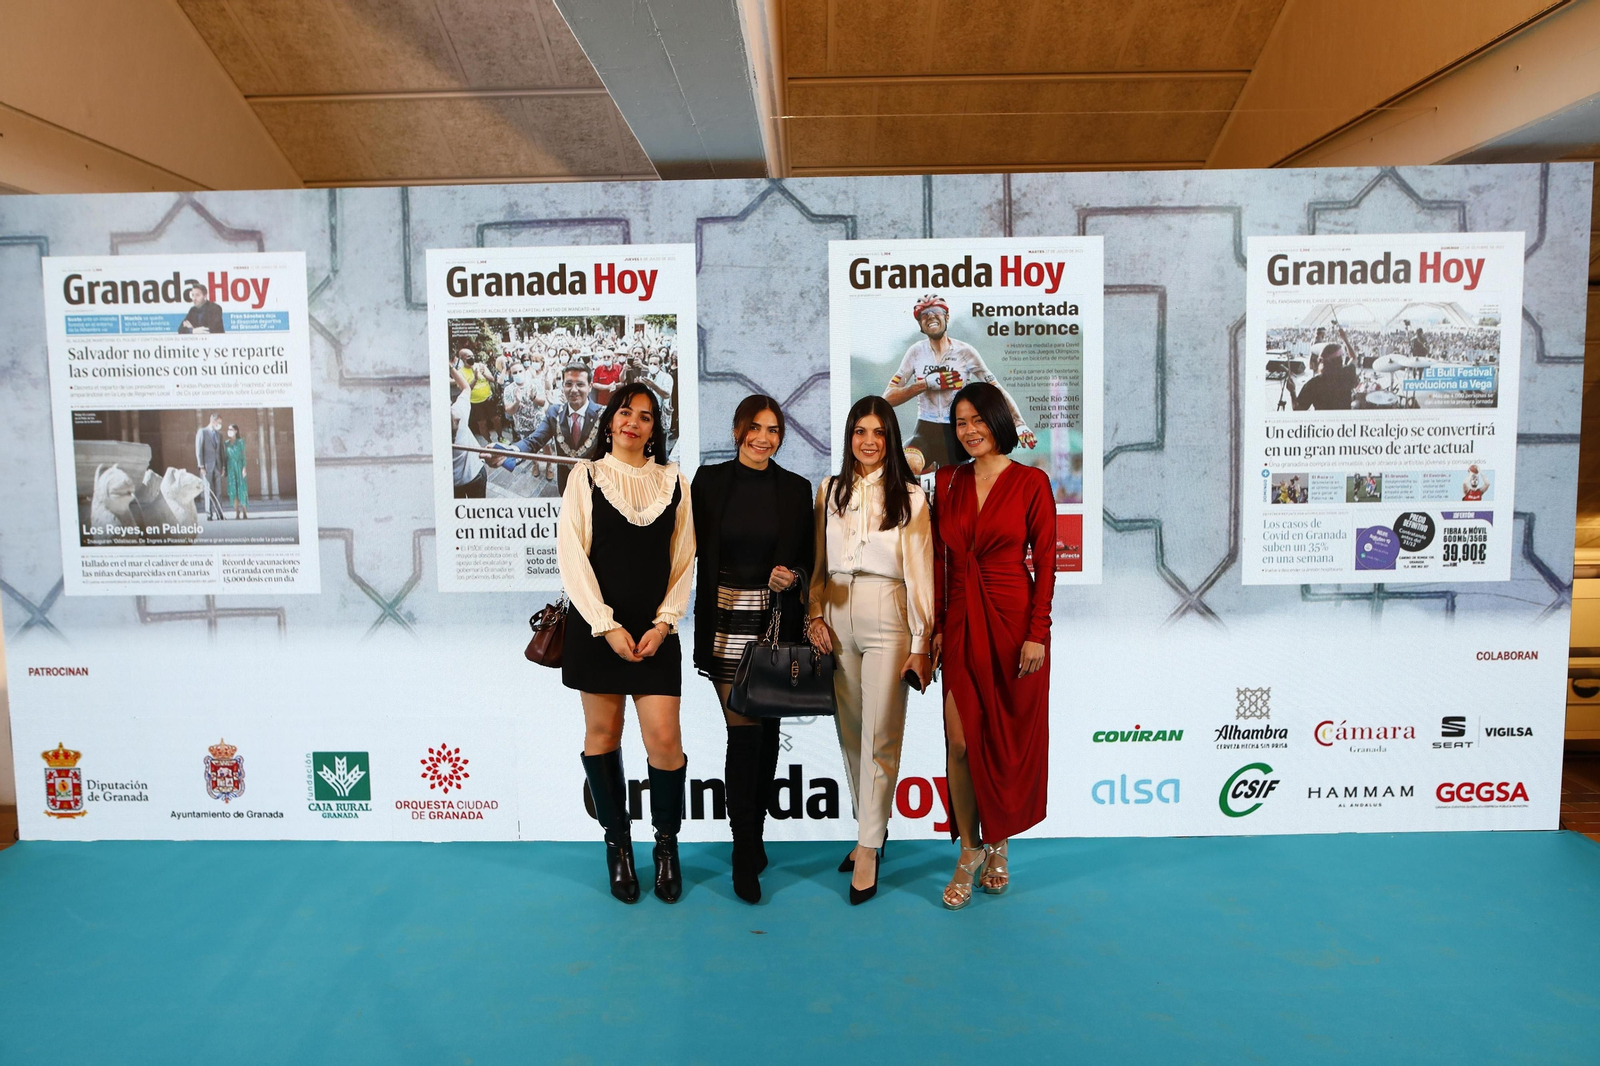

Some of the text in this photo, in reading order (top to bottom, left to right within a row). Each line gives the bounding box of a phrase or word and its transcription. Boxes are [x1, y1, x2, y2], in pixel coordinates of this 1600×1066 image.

[849, 255, 1066, 295] Granada Hoy
[1267, 251, 1486, 291] Granada Hoy
[446, 263, 658, 301] Granada Hoy
[63, 271, 270, 309] Granada Hoy
[971, 301, 1079, 318] Remontada
[987, 320, 1079, 337] de bronce
[68, 345, 285, 361] Salvador no dimite y se reparte
[68, 361, 289, 378] las comisiones con su único edil
[1426, 367, 1492, 377] El Bull Festival
[1405, 380, 1492, 390] revoluciona la Vega
[1039, 412, 1058, 421] poder
[1034, 421, 1049, 429] algo
[1265, 422, 1495, 440] Un edificio del Realejo se convertirá
[1264, 440, 1474, 459] en un gran museo de arte actual
[455, 502, 561, 519] Cuenca vuelv
[1263, 518, 1322, 529] Los casos de
[1409, 513, 1427, 524] PRECIO
[82, 523, 204, 537] Los Reyes, en Palacio
[455, 522, 550, 539] en mitad de
[1402, 519, 1428, 533] DEFINITIVO
[1443, 527, 1462, 535] FIBRA
[1468, 526, 1487, 534] MÓVIL
[1262, 530, 1290, 541] Covid
[1305, 529, 1347, 540] Granada
[1399, 527, 1427, 540] Contratando
[1443, 534, 1488, 543] 600Mb/35GB
[526, 547, 557, 555] El casti
[1262, 542, 1329, 553] suben un 35%
[1443, 543, 1487, 563] 39,90€
[81, 560, 109, 568] Hallado
[144, 559, 151, 567] el
[151, 559, 179, 567] cadáver
[180, 559, 190, 567] de
[222, 558, 301, 566] Récord de vacunaciones
[546, 557, 556, 565] de
[1262, 555, 1334, 564] en una semana
[115, 569, 166, 578] desaparecidas
[177, 569, 210, 577] Canarias
[290, 566, 299, 574] de
[527, 566, 560, 575] Salvado
[246, 575, 264, 583] dosis
[1476, 651, 1539, 661] COLABORAN
[28, 667, 89, 677] PATROCINAN
[1214, 724, 1288, 742] Alhambra
[1314, 719, 1416, 747] Cámara
[1485, 727, 1533, 737] VIGILSA
[1349, 745, 1387, 753] Granada
[1432, 741, 1474, 749] SEAT
[86, 779, 148, 792] Diputación
[1091, 774, 1180, 805] alsa
[1231, 779, 1281, 799] CSIF
[87, 791, 149, 802] de Granada
[1307, 785, 1415, 799] HAMMAM
[308, 802, 372, 812] CAJA RURAL
[395, 800, 499, 810] ORQUESTA CIUDAD
[170, 810, 284, 820] Ayuntamiento de Granada
[412, 811, 484, 820] DE GRANADA
